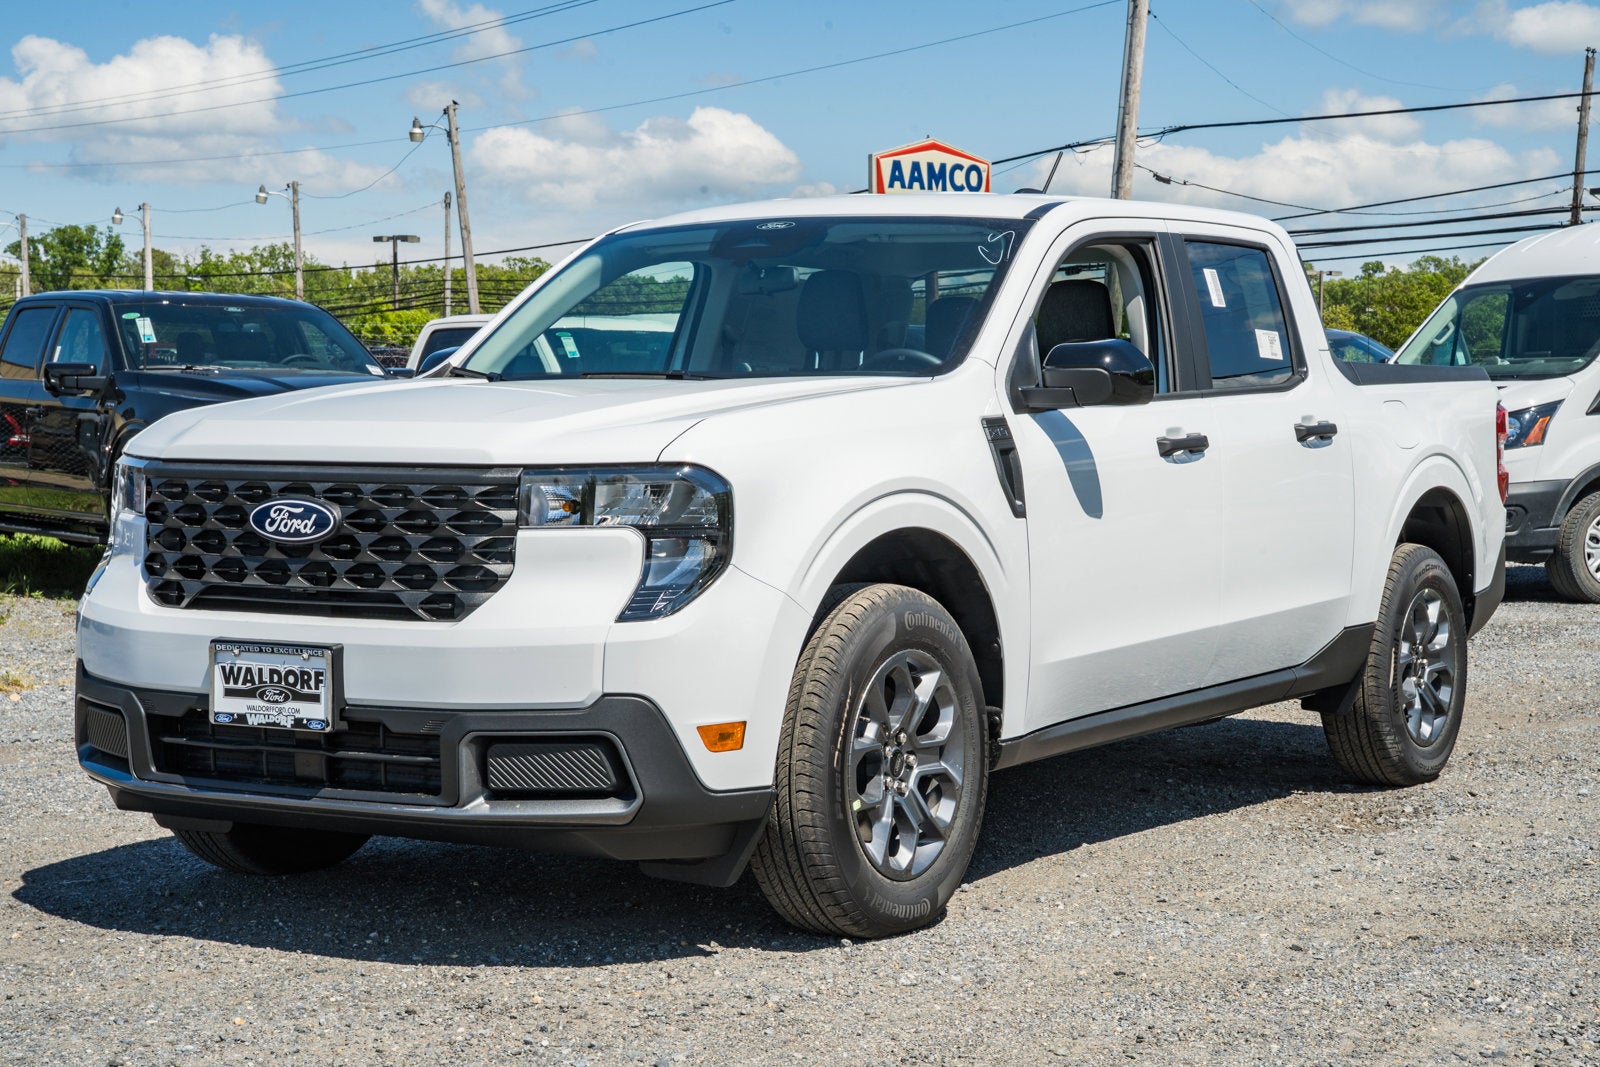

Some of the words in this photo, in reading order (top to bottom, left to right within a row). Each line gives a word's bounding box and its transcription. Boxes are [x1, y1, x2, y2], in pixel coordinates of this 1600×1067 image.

[888, 160, 983, 192] AAMCO
[265, 505, 317, 534] Ford
[904, 610, 958, 644] Continental
[216, 644, 259, 652] DEDICATED
[273, 648, 323, 657] EXCELLENCE
[220, 665, 323, 690] WALDORF
[263, 690, 285, 702] Ford
[246, 705, 301, 714] WALDORFFORD.COM
[246, 713, 295, 728] WALDORF
[870, 892, 931, 920] Continental
